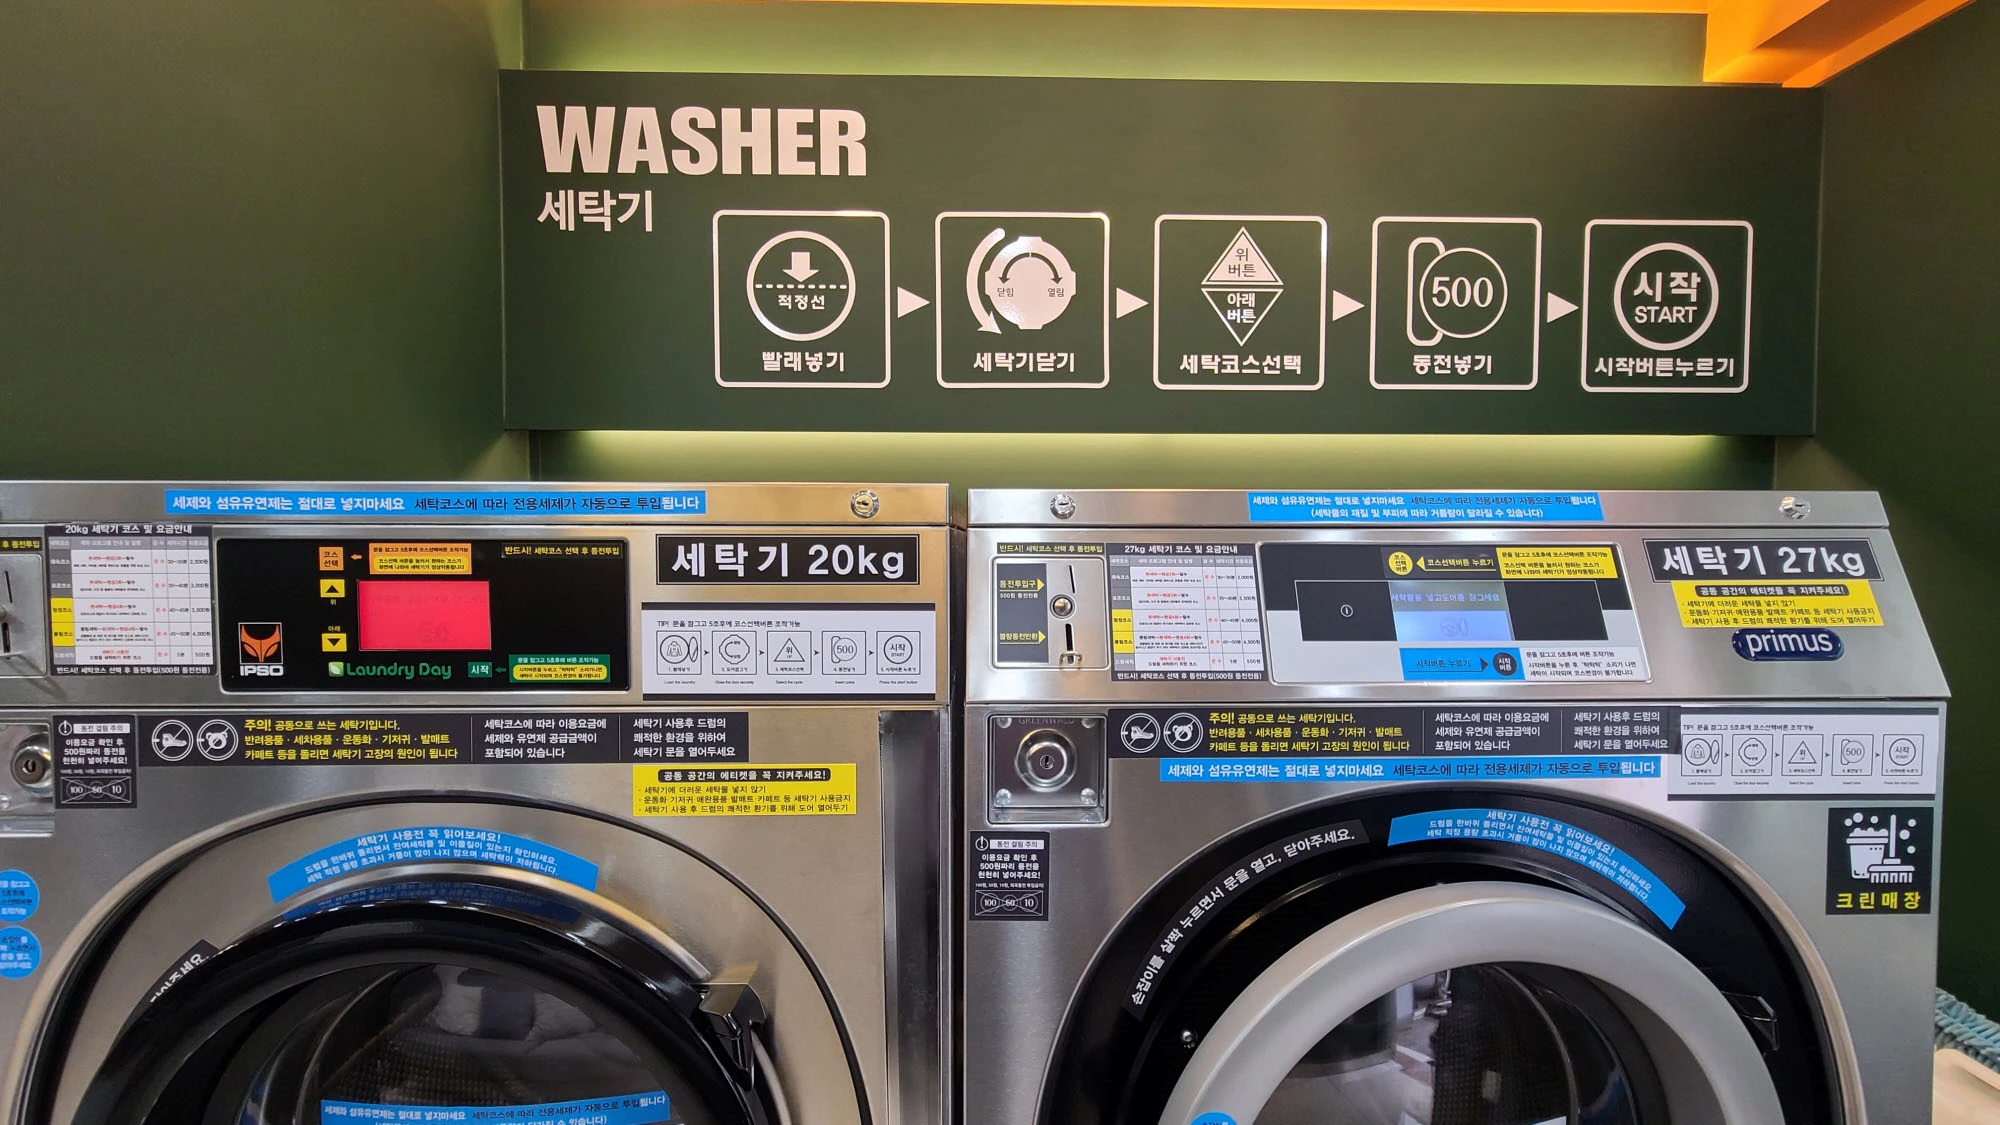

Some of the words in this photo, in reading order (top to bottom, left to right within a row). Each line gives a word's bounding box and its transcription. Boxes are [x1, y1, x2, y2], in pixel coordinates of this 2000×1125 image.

[537, 105, 867, 176] WASHER
[537, 190, 653, 232] 세탁기
[1235, 248, 1249, 261] 위
[1228, 263, 1256, 277] 버튼
[997, 287, 1014, 298] 닫힘
[1048, 287, 1065, 298] 열림
[1431, 276, 1493, 309] 500
[1634, 271, 1701, 303] 시작
[777, 294, 825, 311] 적정선
[1227, 293, 1255, 308] 아래
[1227, 309, 1255, 323] 버튼
[1634, 306, 1697, 324] START
[762, 352, 845, 373] 빨래넣기
[973, 352, 1075, 373] 세탁기닫기
[1180, 355, 1303, 375] 세탁코스선택
[1412, 355, 1493, 375] 동전넣기
[1595, 357, 1734, 377] 시작버튼누르기
[173, 496, 210, 510] 세제와
[216, 496, 292, 510] 섬유유연제는
[298, 497, 336, 510] 절대로
[340, 497, 405, 511] 넣지마세요
[414, 498, 477, 510] 세탁코스에
[483, 498, 507, 510] 따라
[513, 498, 576, 510] 전용세제가
[581, 498, 632, 510] 자동으로
[637, 496, 699, 510] 투입됩니다
[65, 526, 88, 534] 20kg
[92, 525, 119, 533] 세탁기
[122, 525, 140, 533] 코스
[144, 525, 152, 533] 및
[156, 525, 192, 533] 요금안내
[504, 546, 531, 555] 반드시!
[534, 547, 562, 555] 세탁코스
[565, 547, 579, 555] 선택
[581, 547, 589, 555] 후
[591, 547, 619, 555] 동전투입
[1125, 545, 1145, 554] 27kg
[1149, 545, 1173, 554] 세탁기
[1176, 545, 1192, 554] 코스
[1195, 545, 1203, 554] 및
[1206, 545, 1237, 554] 요금안내
[324, 559, 338, 568] 선택
[672, 543, 789, 577] 세탁기
[808, 545, 904, 579] 20kg
[1428, 559, 1469, 567] 코스선택버튼
[1663, 545, 1767, 575] 세탁기
[1777, 546, 1865, 576] 27kg
[1000, 580, 1036, 588] 동전투입구
[890, 644, 906, 652] 시작
[1746, 629, 1833, 656] primus
[837, 645, 853, 654] 500
[240, 665, 283, 676] IPSO
[346, 662, 415, 679] Laundry
[419, 663, 451, 679] Day
[471, 665, 489, 675] 시작
[244, 720, 271, 731] 주의!
[275, 720, 314, 730] 공동으로
[317, 720, 336, 730] 쓰는
[340, 720, 400, 731] 세탁기입니다.
[484, 719, 532, 729] 세탁코스에
[536, 719, 554, 729] 따라
[558, 719, 606, 729] 이용요금에
[634, 718, 662, 728] 세탁기
[665, 718, 694, 728] 사용후
[698, 718, 726, 728] 드럼의
[244, 735, 284, 745] 반려용품
[294, 735, 332, 745] 세차용품
[342, 735, 372, 745] 운동화
[382, 734, 410, 745] 기저귀
[420, 734, 450, 744] 발매트
[484, 734, 514, 744] 세제와
[517, 733, 546, 743] 유연제
[549, 733, 596, 744] 공급금액이
[634, 733, 662, 743] 쾌적한
[665, 732, 694, 742] 환경을
[698, 732, 726, 742] 위하여
[245, 750, 274, 760] 카페트
[278, 750, 296, 760] 등을
[300, 749, 329, 760] 돌리면
[332, 749, 361, 759] 세탁기
[364, 749, 394, 759] 고장의
[396, 749, 425, 759] 원인이
[429, 748, 458, 758] 됩니다
[484, 748, 523, 758] 포함되어
[526, 748, 565, 758] 있습니다
[634, 747, 662, 757] 세탁기
[665, 747, 684, 757] 문을
[688, 747, 735, 757] 열어두세요
[664, 772, 682, 780] 공동
[688, 772, 715, 780] 공간의
[721, 771, 757, 780] 에티켓을
[763, 771, 771, 780] 꼭
[777, 771, 826, 780] 지켜주세요!
[1168, 765, 1203, 777] 세제와
[1209, 765, 1280, 777] 섬유유연제는
[1285, 765, 1320, 777] 절대로
[1325, 765, 1384, 777] 넣지마세요
[1394, 764, 1451, 776] 세탁코스에
[1457, 765, 1479, 775] 따라
[1484, 763, 1542, 775] 전용세제가
[1547, 763, 1592, 774] 자동으로
[1598, 761, 1655, 774] 투입됩니다
[644, 786, 675, 794] 세탁기에
[679, 786, 702, 794] 더러운
[751, 785, 766, 793] 않기
[357, 834, 388, 847] 세탁기
[393, 830, 424, 840] 사용전
[428, 830, 439, 838] 꼭
[444, 829, 500, 843] 읽어보세요!
[1487, 811, 1516, 821] 세탁기
[1520, 815, 1549, 829] 사용전
[1553, 824, 1562, 834] 꼭
[1566, 828, 1615, 856] 읽어보세요!
[1836, 892, 1920, 910] 크린매장
[1131, 954, 1165, 1005] 손잡이를
[1160, 929, 1183, 954] 살짝
[1180, 886, 1224, 929] 누르면서
[1224, 868, 1250, 891] 문을
[1250, 853, 1282, 873] 열고,
[1284, 828, 1355, 857] 닫아주세요.
